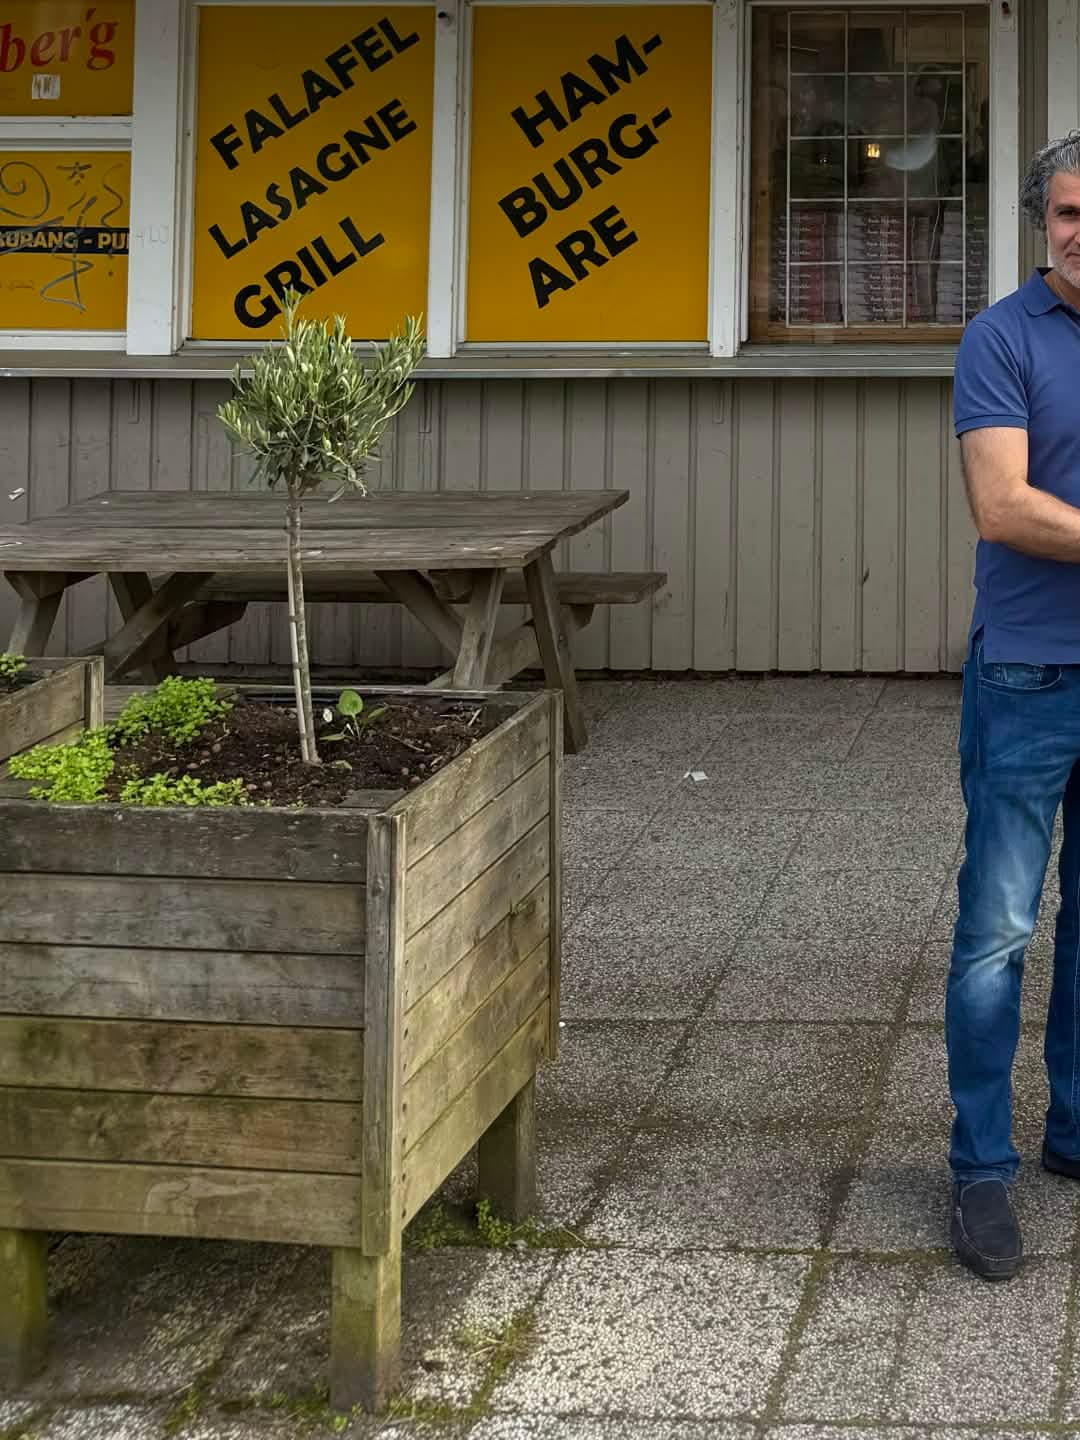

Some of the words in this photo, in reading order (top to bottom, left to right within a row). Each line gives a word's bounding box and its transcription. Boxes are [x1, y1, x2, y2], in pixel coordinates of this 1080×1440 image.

[209, 17, 420, 171] FALAFEL
[510, 33, 663, 149] HAM-
[207, 98, 418, 260] LASAGNE
[497, 106, 673, 239] BURG-
[97, 231, 129, 250] PU
[233, 216, 386, 329] GRILL
[528, 204, 639, 309] ARE
